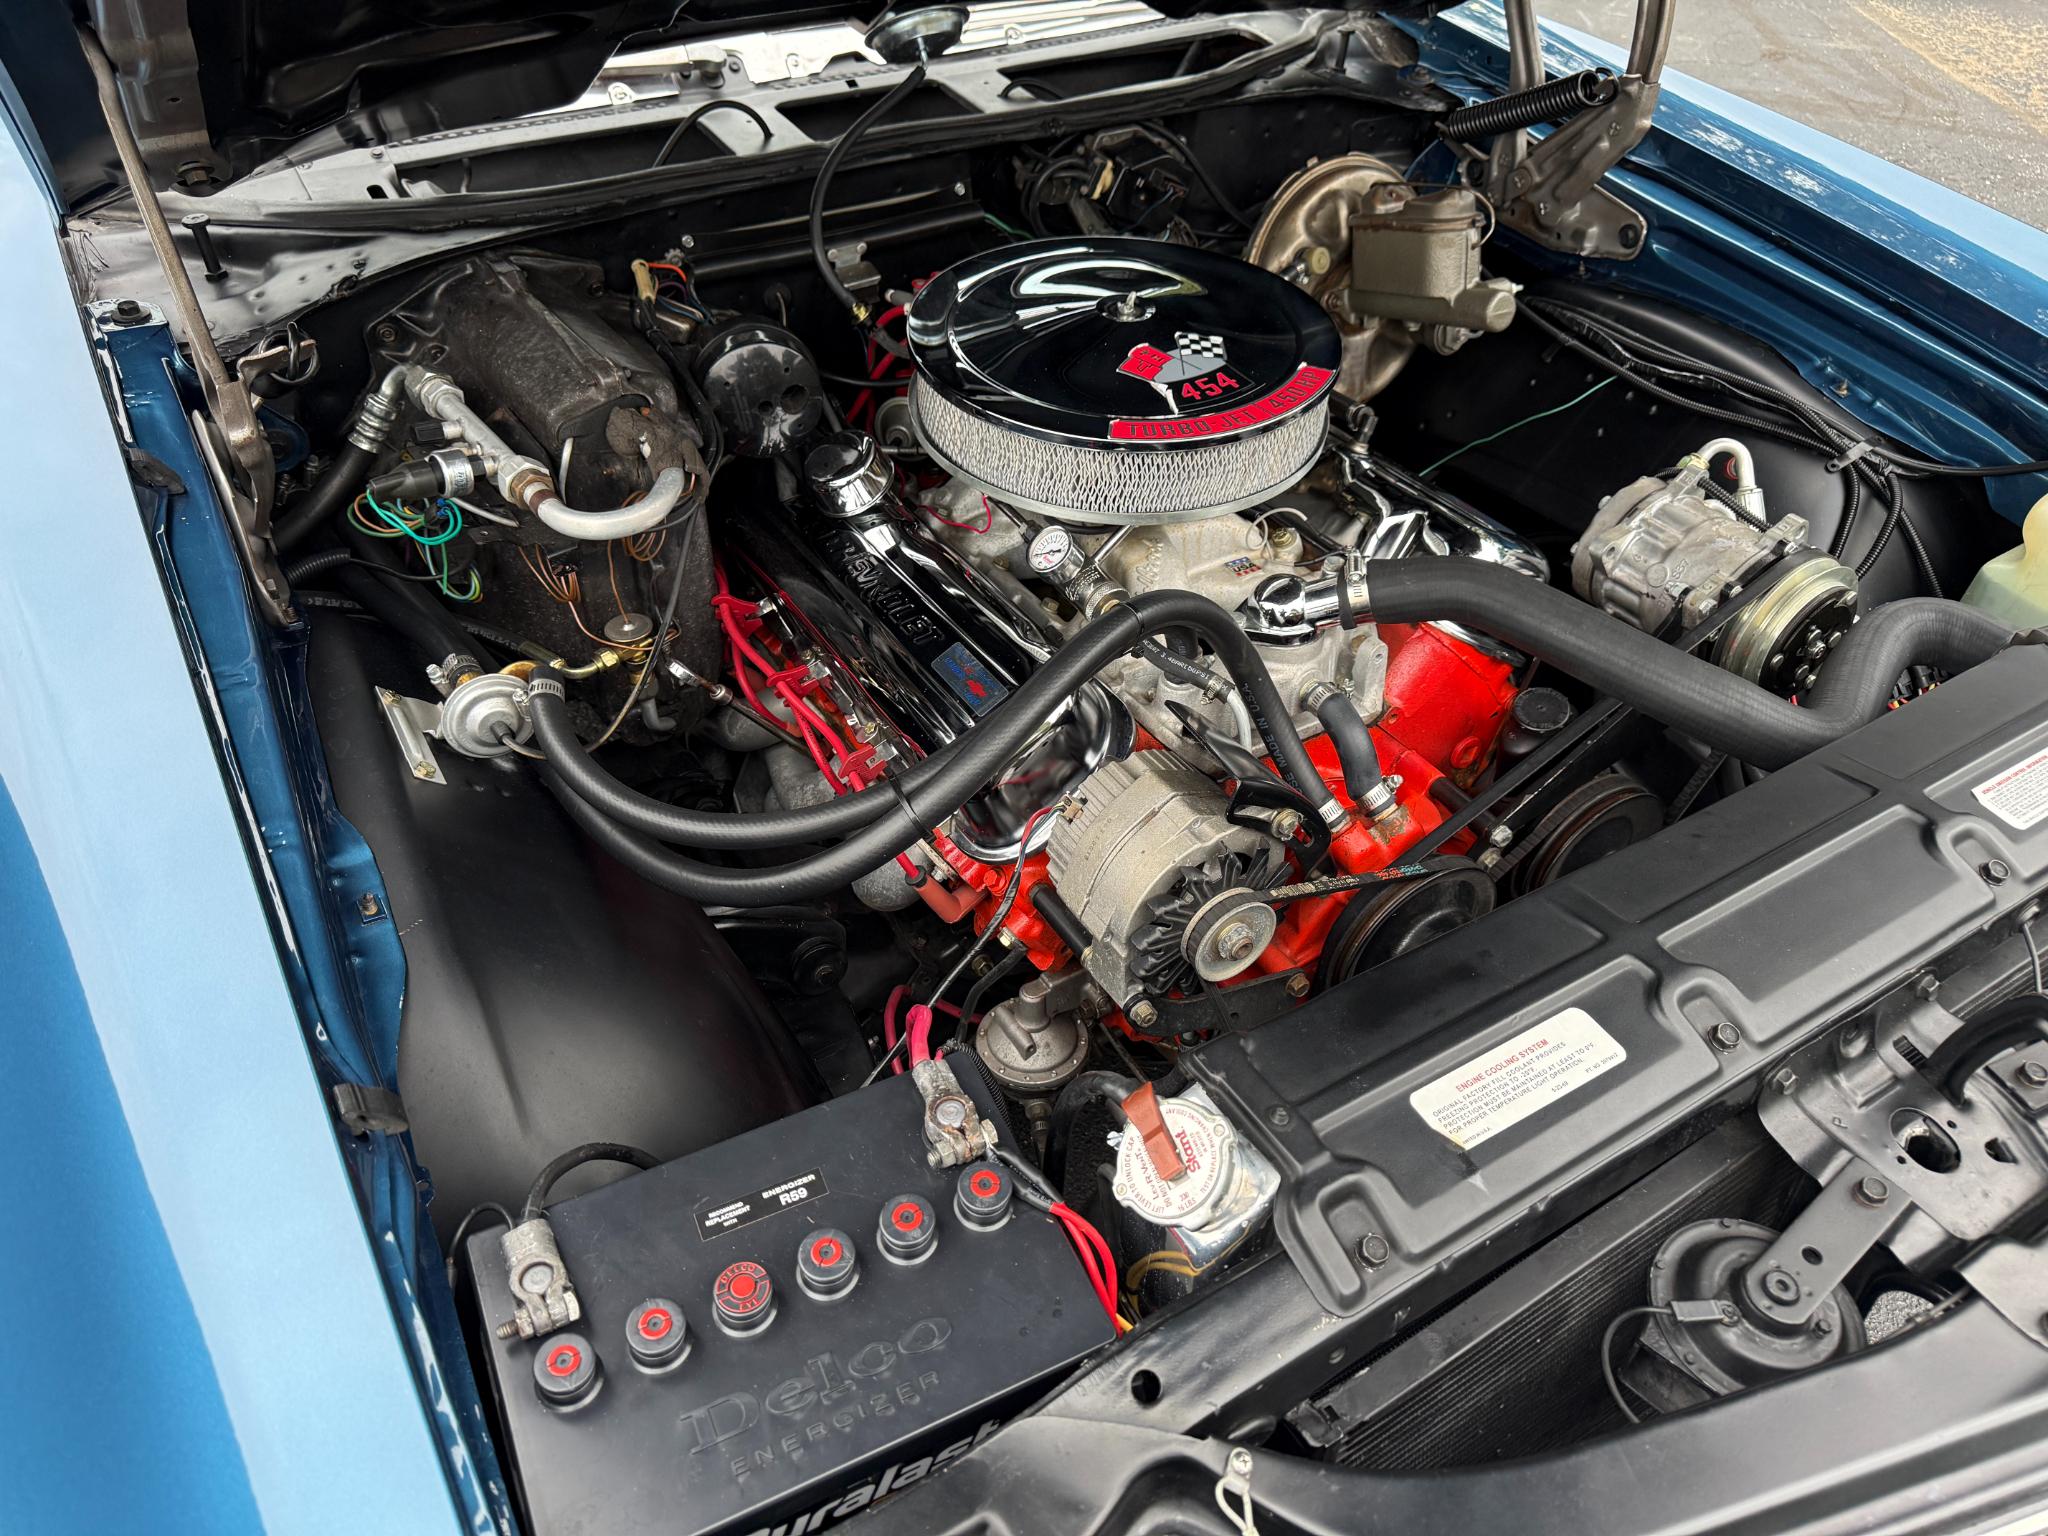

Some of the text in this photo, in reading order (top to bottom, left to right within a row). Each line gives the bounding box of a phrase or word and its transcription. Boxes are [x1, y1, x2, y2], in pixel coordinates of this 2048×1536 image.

[1182, 372, 1239, 400] 454
[1130, 410, 1257, 437] TURBO-JET
[1300, 371, 1323, 389] HP
[1238, 681, 1260, 713] U.S.A.
[1256, 715, 1269, 730] IN
[1264, 732, 1288, 768] MADE
[1432, 1041, 1566, 1117] ORIGINAL FACTORY FILL COOLANT PROVIDES
[1455, 1038, 1549, 1092] ENGINE COOLING SYSTEM
[1437, 1103, 1469, 1123] FREEZING
[1468, 1081, 1509, 1106] PROTECTION
[1508, 1075, 1519, 1083] TO
[1443, 1104, 1483, 1129] PROTECTION
[1483, 1094, 1501, 1107] MUST
[1501, 1089, 1511, 1097] BE
[1510, 1068, 1548, 1091] MAINTAINED
[1555, 1052, 1576, 1066] LEAST
[1574, 1047, 1585, 1055] TO
[1448, 1125, 1463, 1135] FOR
[1462, 1110, 1488, 1127] PROPER
[1487, 1086, 1532, 1113] TEMPERATURE
[1530, 1076, 1550, 1089] LIGHT
[1173, 1129, 1201, 1173] Stant
[762, 1174, 816, 1199] ENERGIZER
[1124, 1136, 1164, 1213] LIFT LEVER TO UNLOCK CAP
[1158, 1183, 1168, 1198] NOT
[708, 1202, 744, 1218] RECOMMEND
[779, 1187, 808, 1206] R59
[1163, 1196, 1172, 1208] DO
[705, 1204, 750, 1226] REPLACEMENT
[723, 1218, 738, 1226] WITH
[720, 1264, 756, 1284] DELCO
[680, 1318, 952, 1456] Delco
[730, 1370, 940, 1478] ENERGIZER
